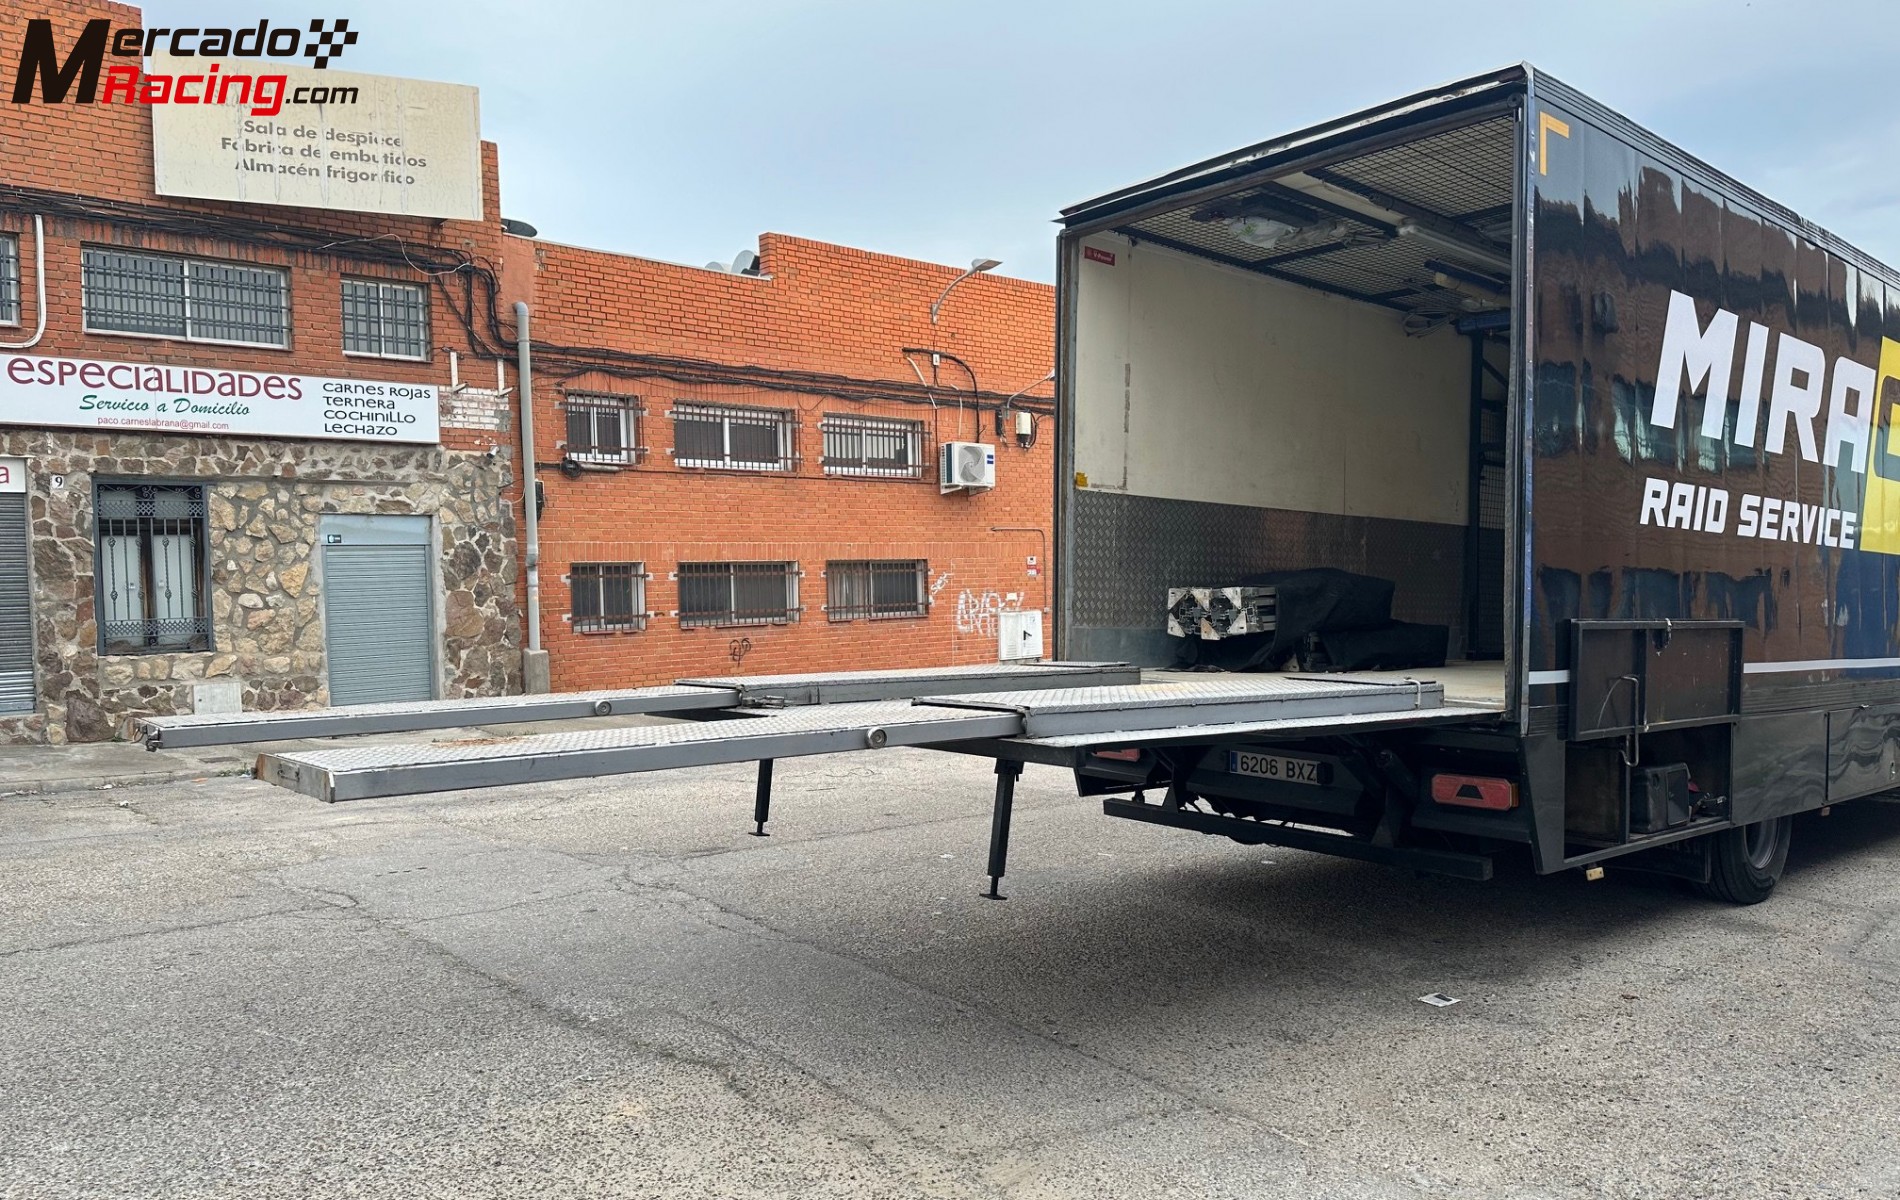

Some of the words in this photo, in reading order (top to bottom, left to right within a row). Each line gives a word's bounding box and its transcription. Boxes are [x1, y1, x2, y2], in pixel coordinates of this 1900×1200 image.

[244, 120, 287, 136] Sala
[293, 125, 317, 139] de
[300, 145, 321, 159] de
[235, 158, 320, 177] Almacén
[327, 165, 415, 185] frigorfico
[79, 395, 149, 411] Servicio
[157, 402, 168, 413] a
[173, 398, 250, 415] Domicilio
[55, 476, 63, 487] 9
[1640, 477, 1729, 534] RAID
[1737, 494, 1857, 549] SERVICE
[1240, 755, 1279, 776] 6206
[1286, 761, 1316, 781] BXZ
